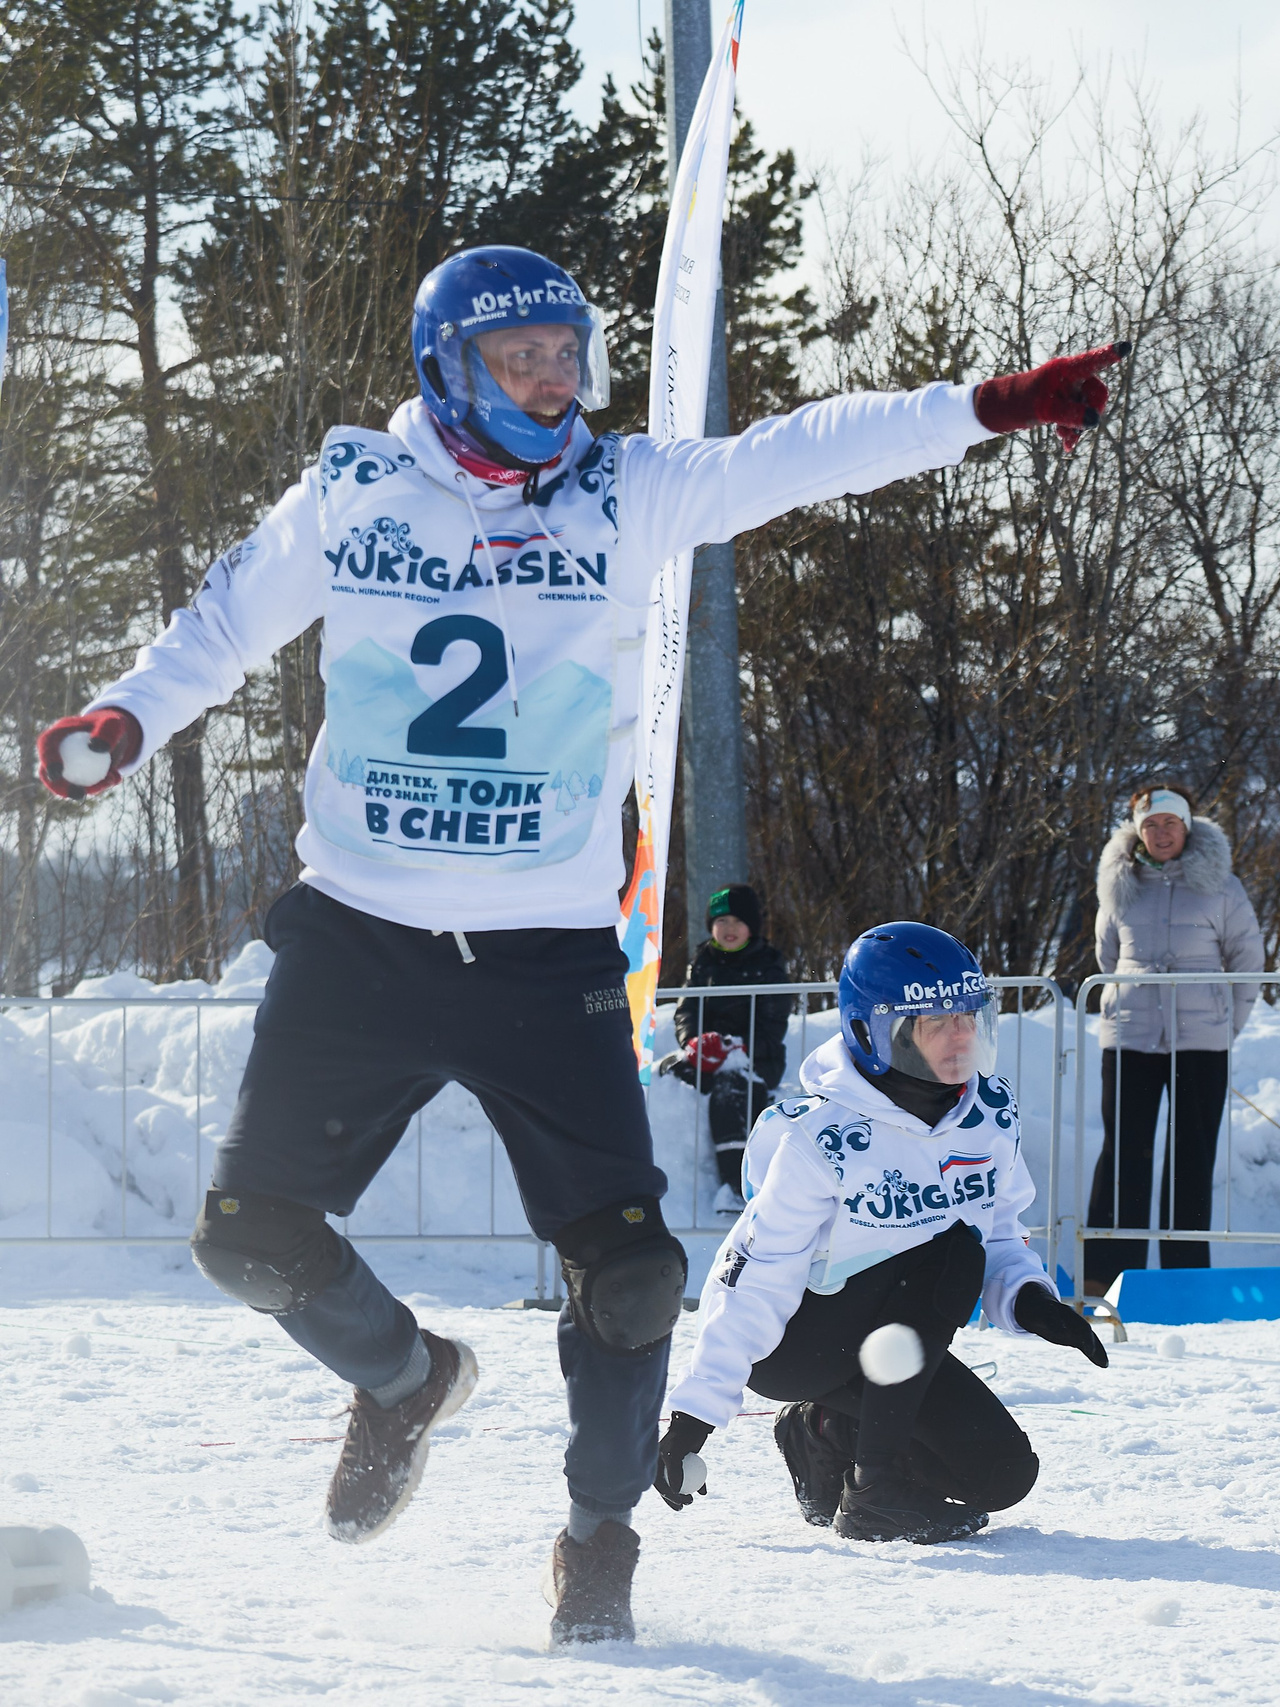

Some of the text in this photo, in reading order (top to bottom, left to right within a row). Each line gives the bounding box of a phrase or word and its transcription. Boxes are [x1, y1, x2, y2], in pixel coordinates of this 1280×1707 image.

[358, 587, 403, 599] MURMANSK
[404, 592, 440, 604] REGION
[538, 592, 587, 602] СНЕЖНЫЙ
[407, 614, 514, 759] 2
[366, 771, 438, 790] ДЛЯ ТЕХ,
[365, 786, 438, 803] КТО ЗНАЕТ
[447, 778, 545, 807] ТОЛК
[365, 802, 541, 845] В СНЕГЕ
[849, 1214, 946, 1229] RUSSIA, MURMANSK REGION
